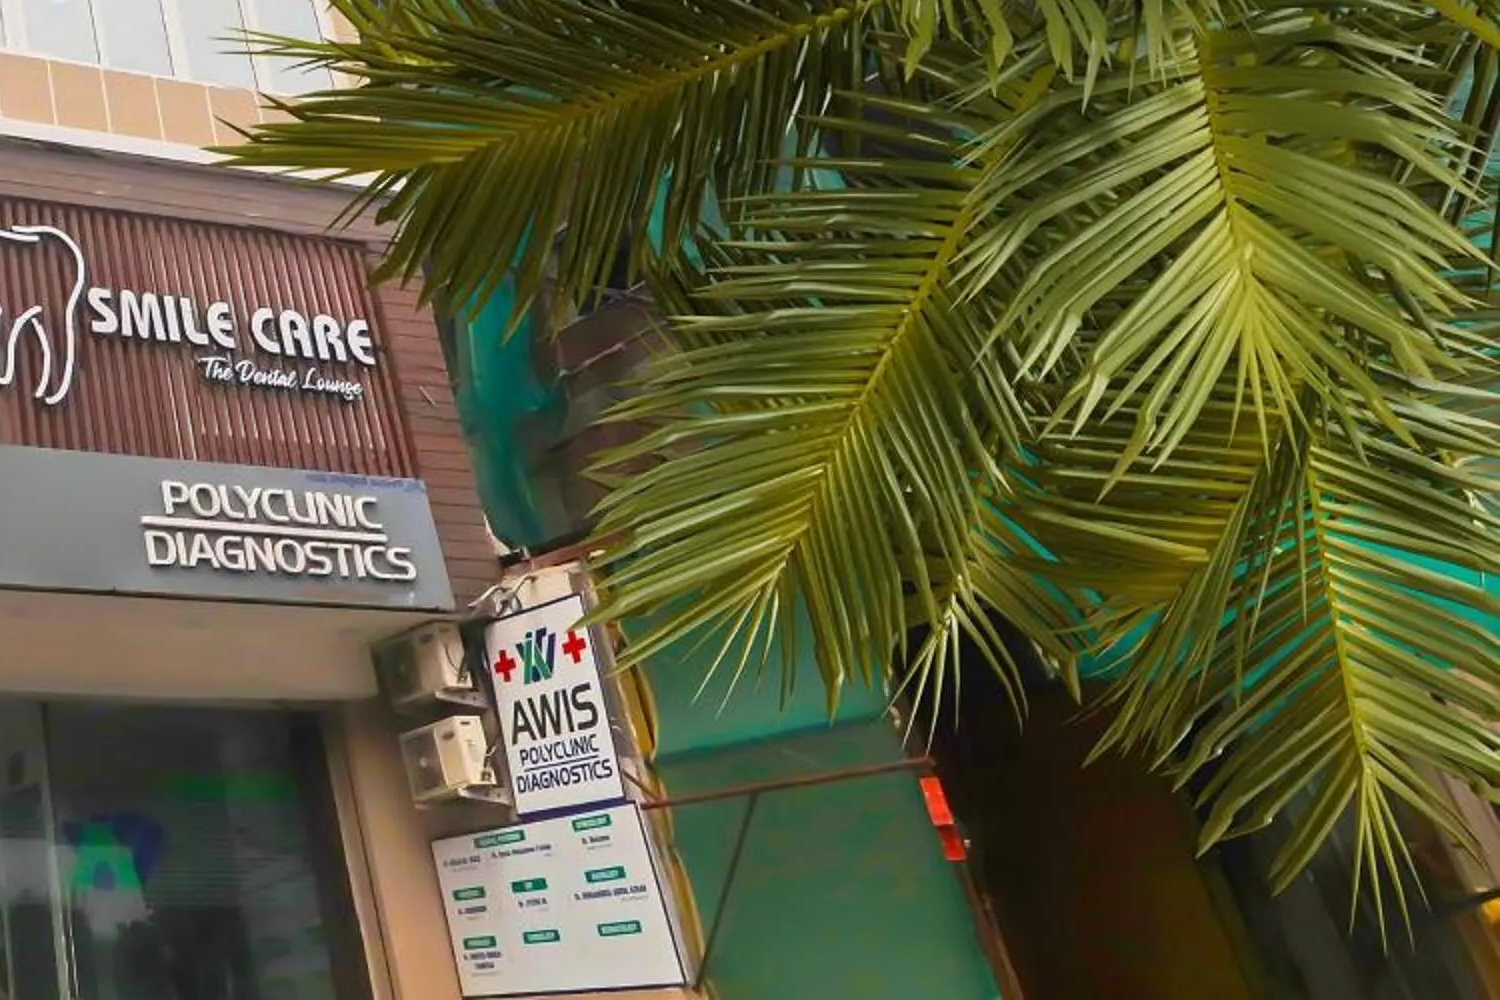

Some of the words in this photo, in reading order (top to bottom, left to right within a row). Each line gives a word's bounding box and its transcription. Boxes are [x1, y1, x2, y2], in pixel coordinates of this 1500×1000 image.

[88, 287, 237, 349] SMILE
[251, 307, 376, 365] CARE
[198, 356, 233, 380] The
[236, 359, 297, 389] Dental
[302, 366, 365, 400] Lounge
[161, 480, 383, 530] POLYCLINIC
[143, 530, 418, 581] DIAGNOSTICS
[512, 682, 599, 745] AWIS
[519, 734, 599, 767] POLYCLINIC
[516, 758, 613, 794] DIAGNOSTICS
